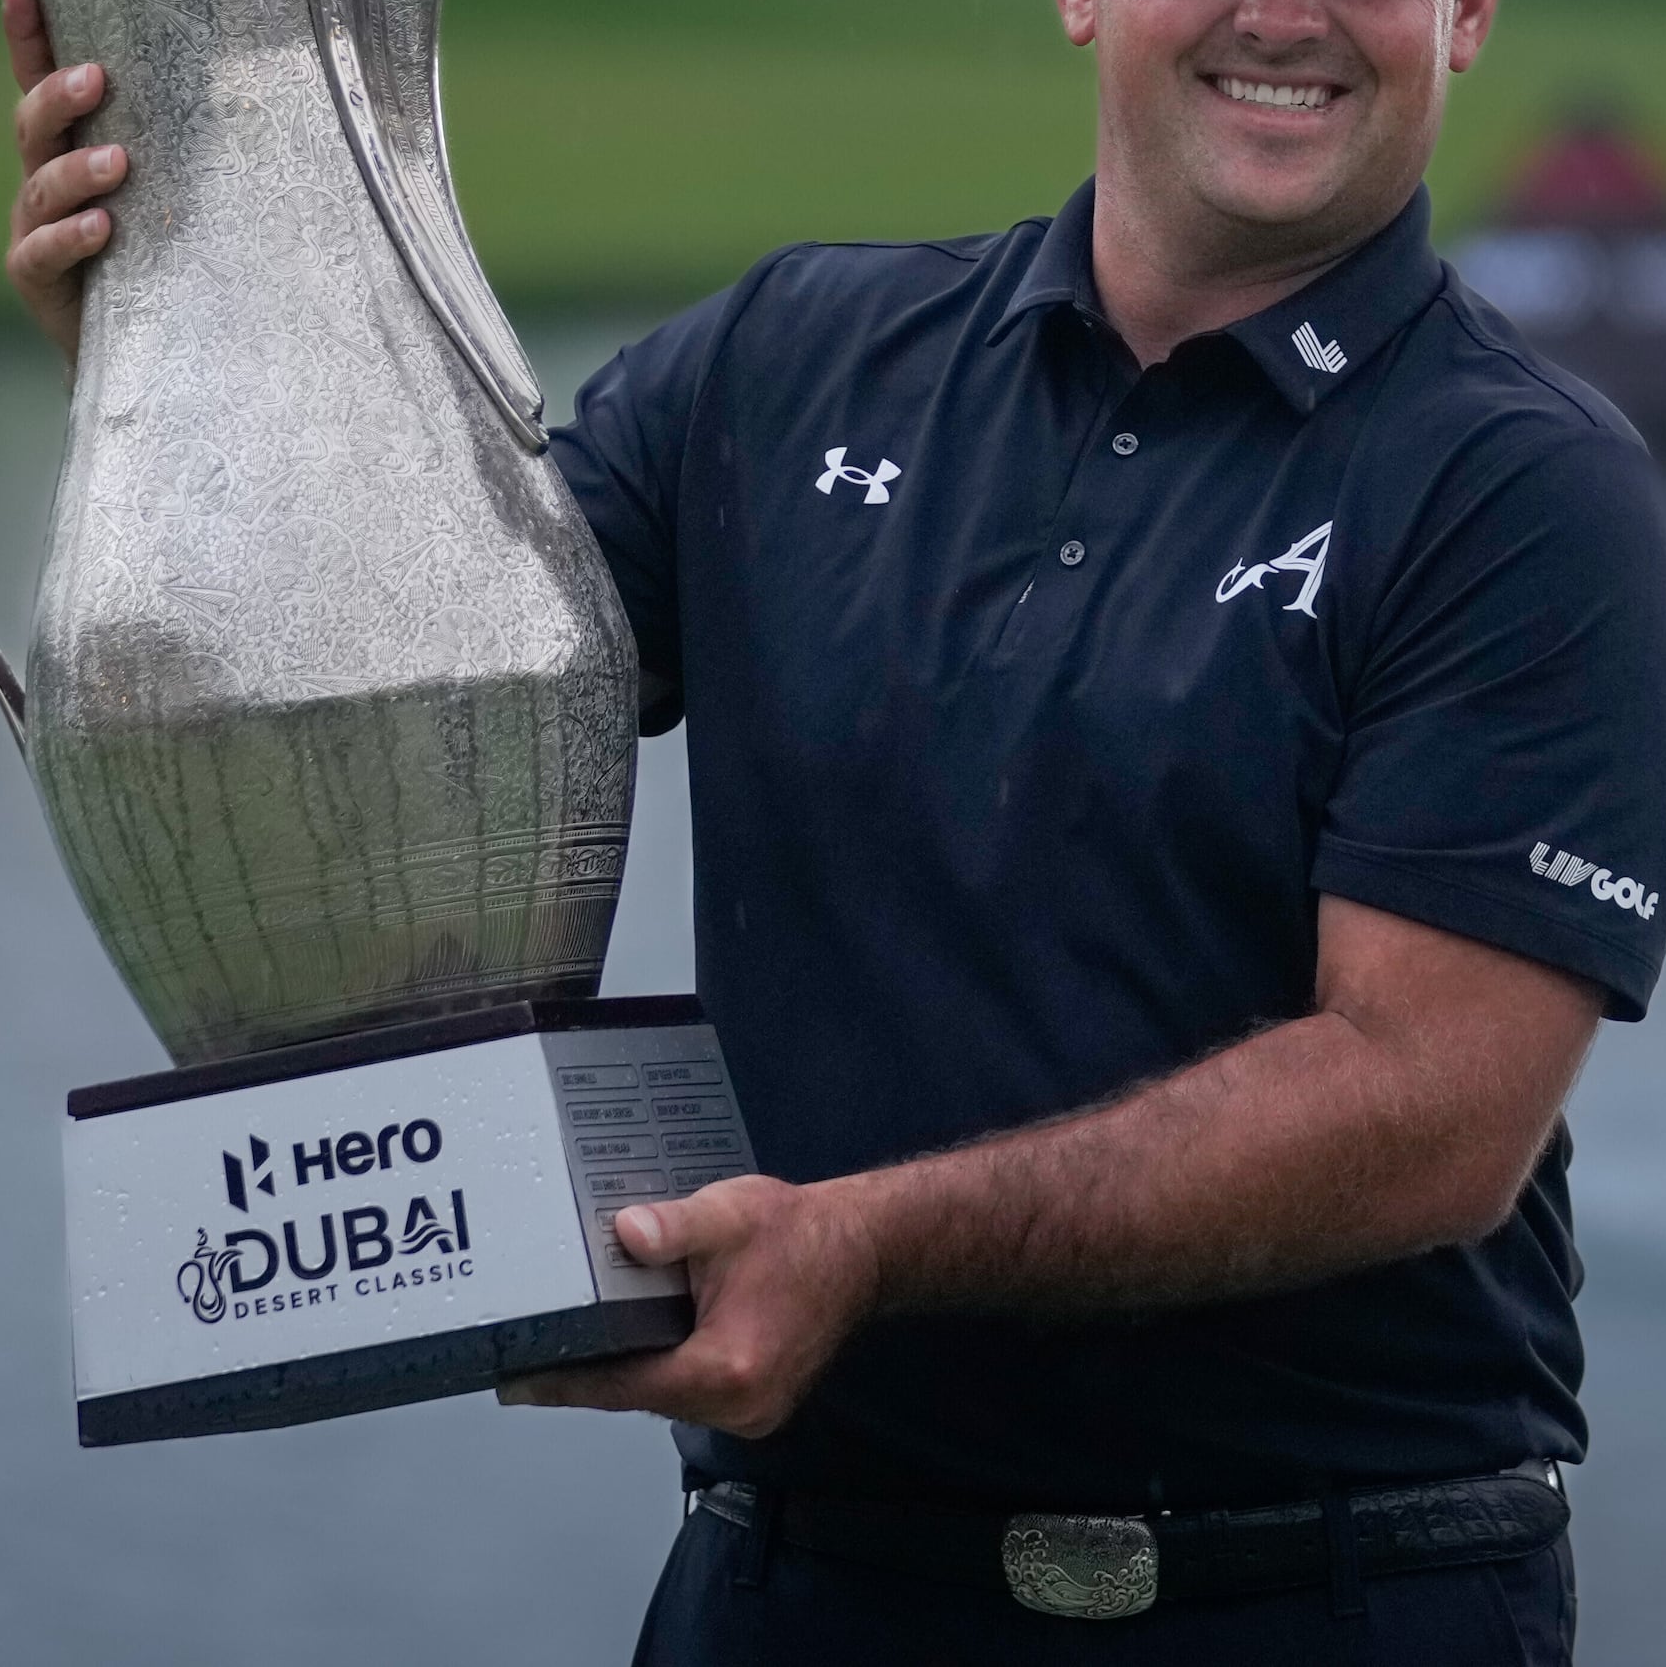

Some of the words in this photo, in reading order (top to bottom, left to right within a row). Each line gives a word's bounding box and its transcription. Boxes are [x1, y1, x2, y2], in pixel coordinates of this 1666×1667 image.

[292, 1118, 443, 1186] Hero
[225, 1188, 471, 1294] DUBAI
[234, 1284, 339, 1319] DESERT
[355, 1259, 475, 1296] CLASSIC
